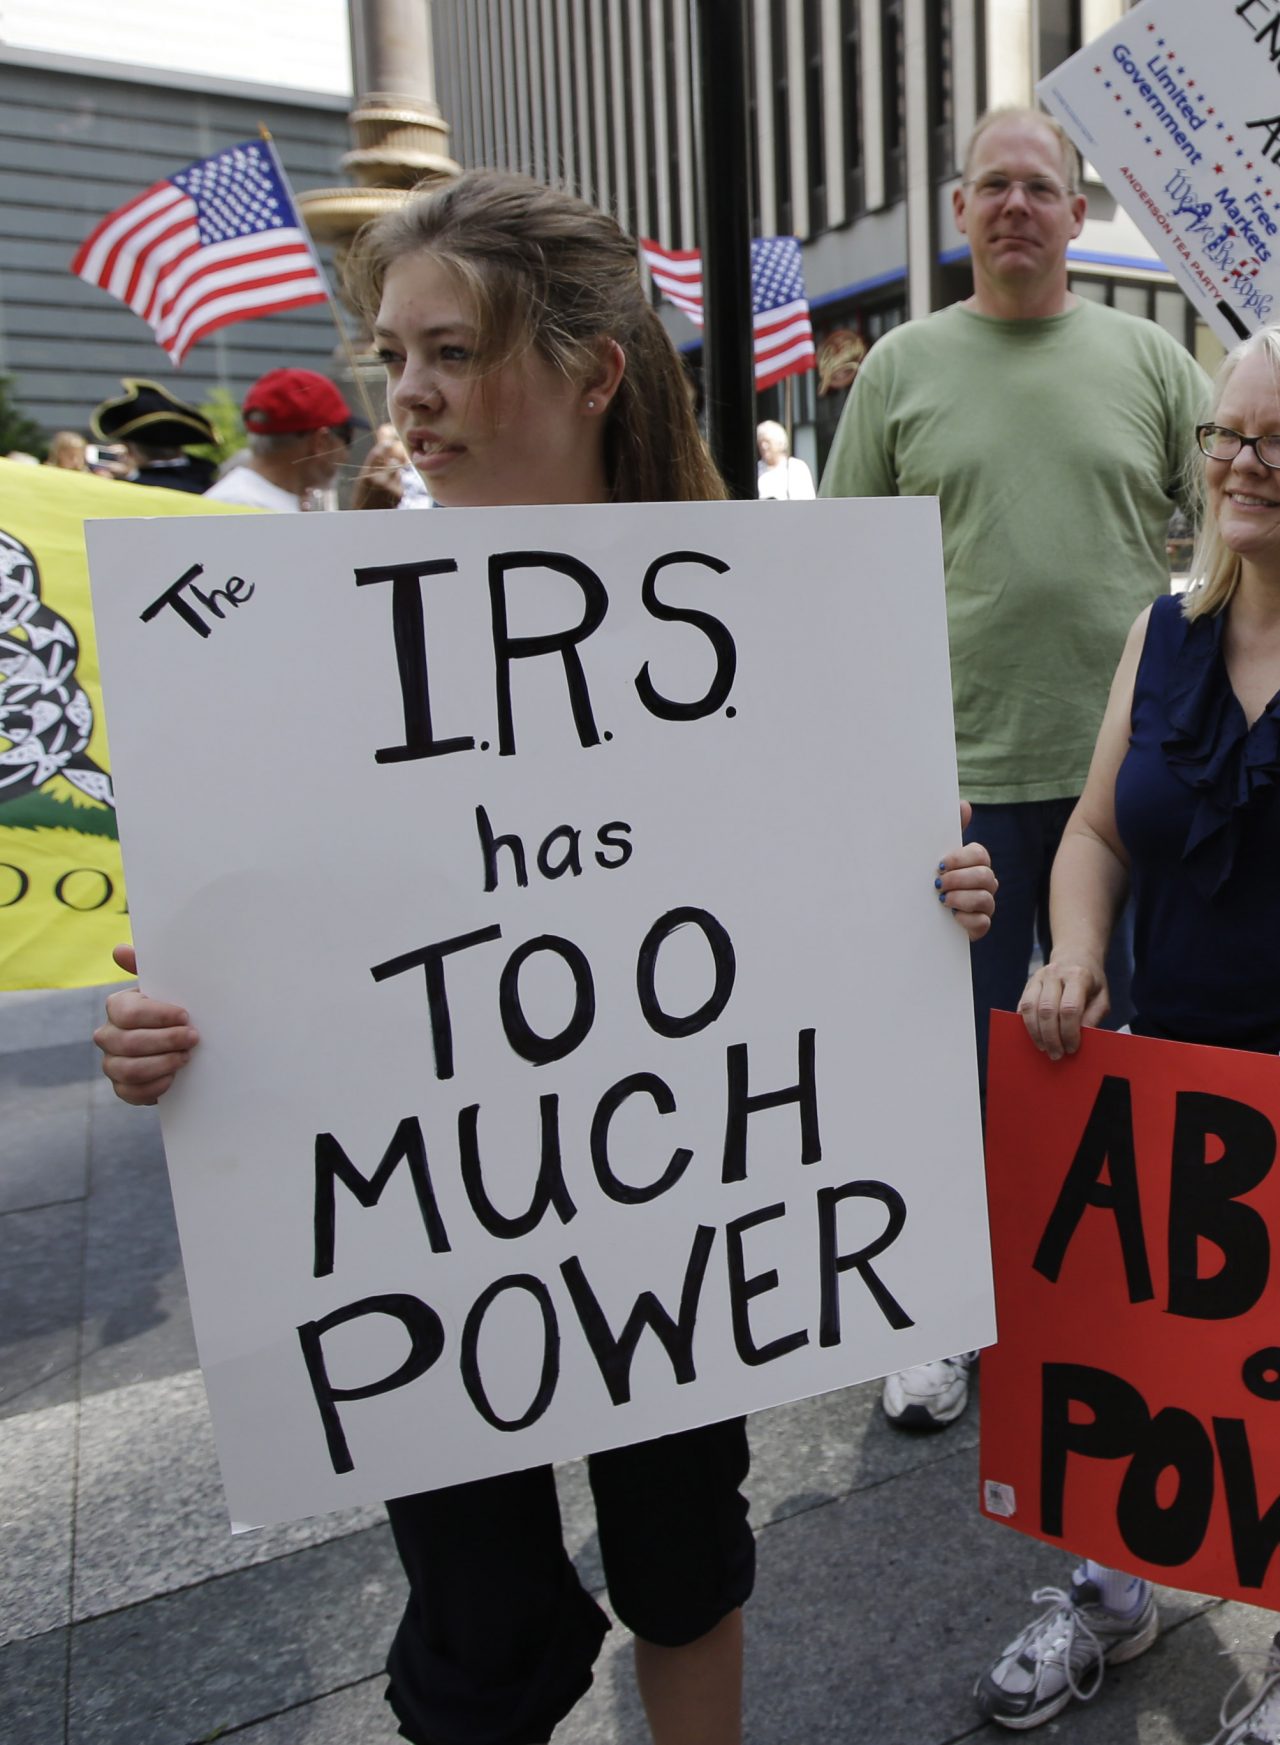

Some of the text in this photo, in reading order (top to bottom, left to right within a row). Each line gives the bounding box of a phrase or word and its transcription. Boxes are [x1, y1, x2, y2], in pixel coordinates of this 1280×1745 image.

[1112, 44, 1202, 165] Government
[1146, 54, 1207, 131] Limited
[1120, 166, 1173, 235] ANDERSON
[1172, 235, 1191, 261] TEA
[1190, 261, 1223, 300] PARTY
[1215, 187, 1272, 262] Markets
[1244, 191, 1278, 236] Free
[139, 550, 738, 764] The I.R.S.
[475, 805, 634, 892] has
[371, 906, 737, 1080] TOO
[313, 1028, 822, 1278] MUCH
[297, 1179, 915, 1474] POWER
